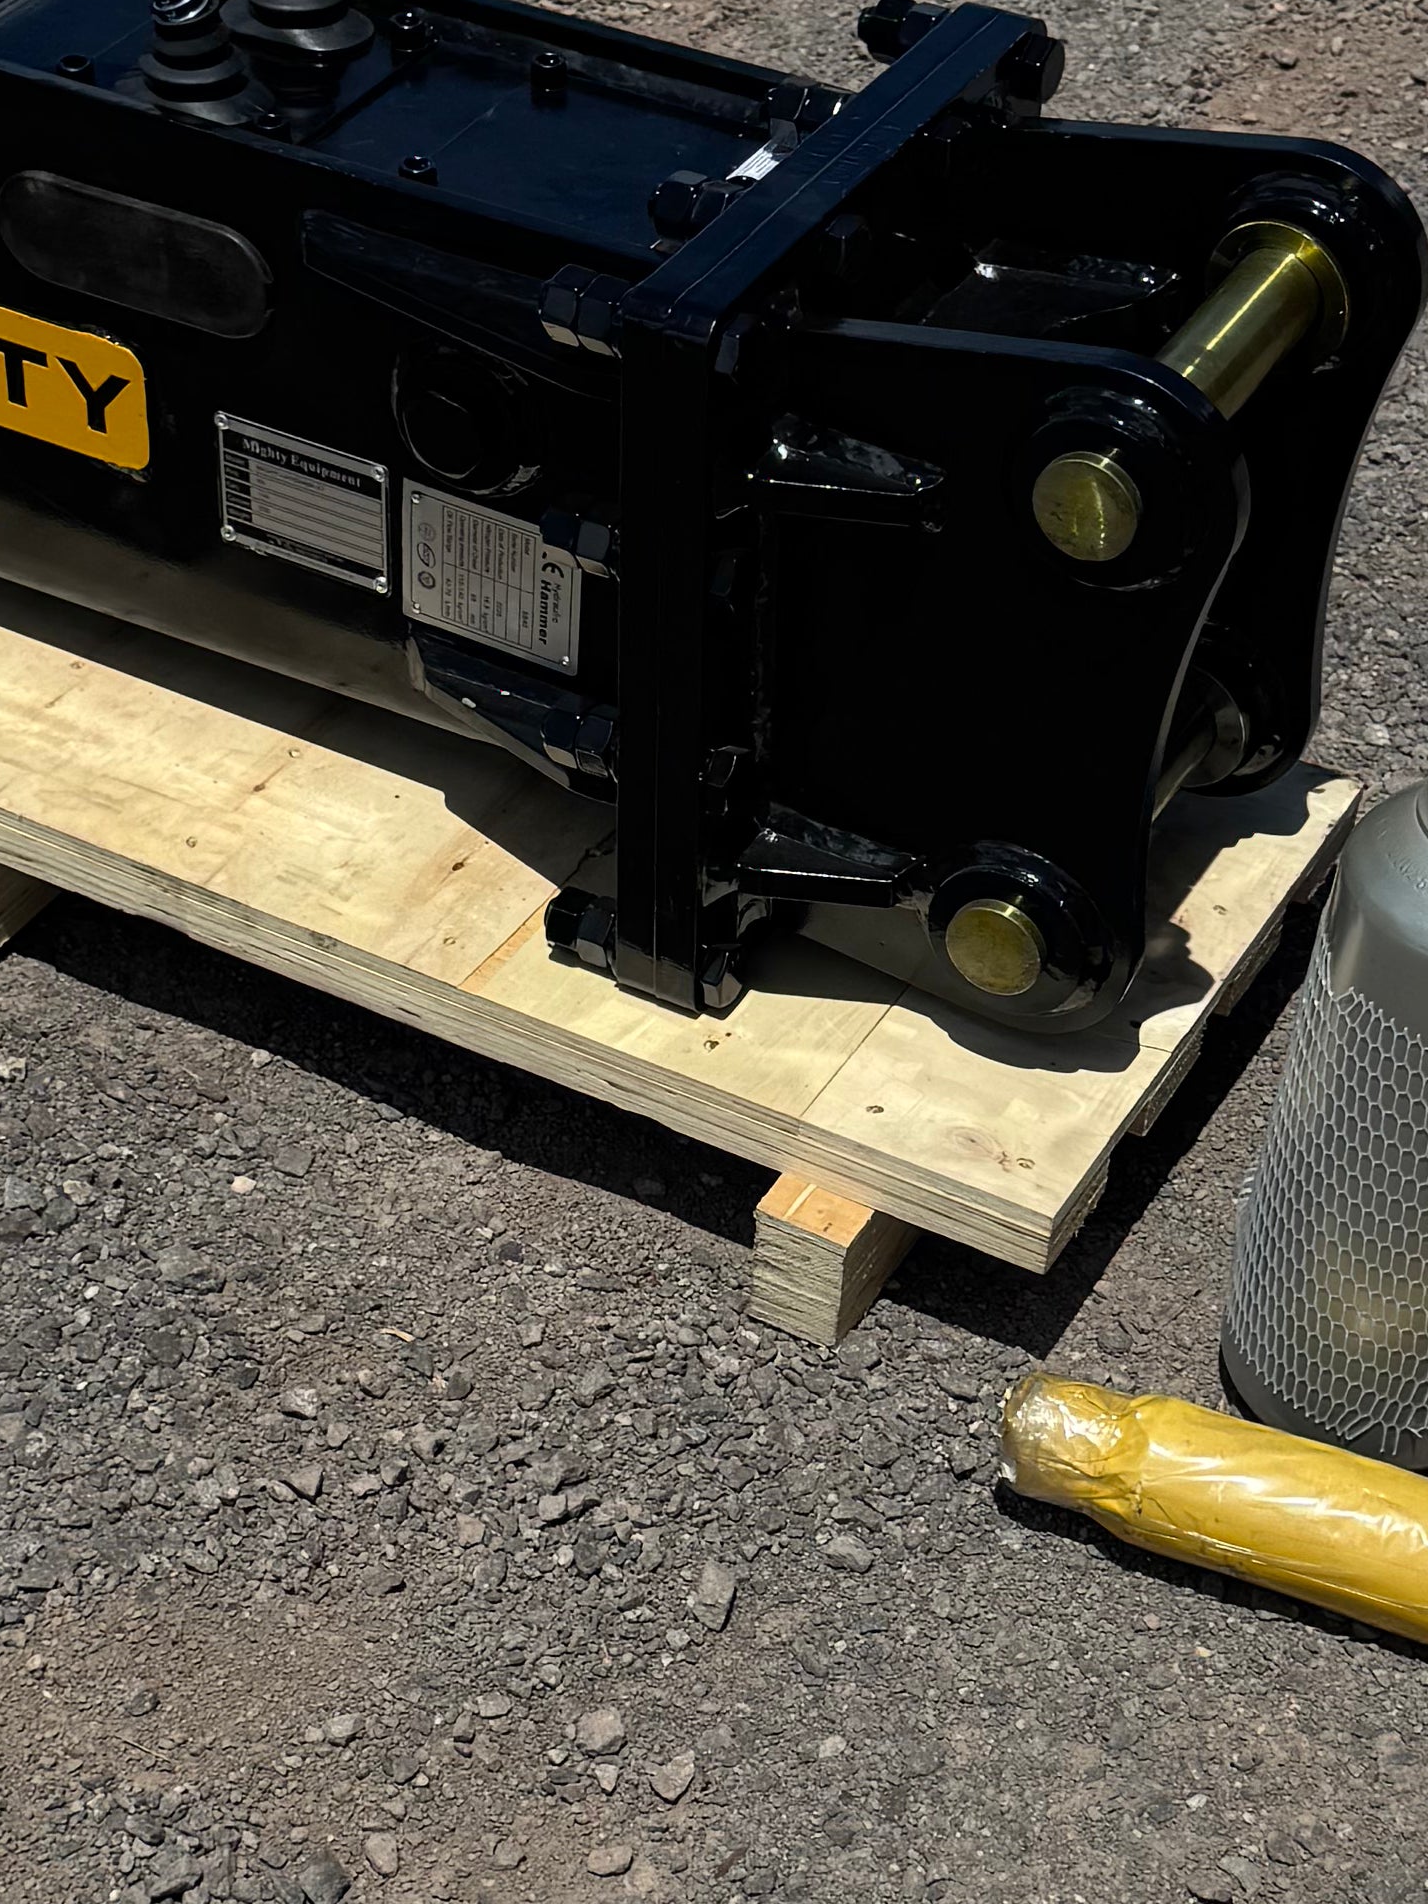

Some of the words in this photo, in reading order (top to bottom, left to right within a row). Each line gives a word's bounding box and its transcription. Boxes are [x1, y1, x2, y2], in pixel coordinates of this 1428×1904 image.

[242, 437, 287, 464] Mighty
[290, 453, 361, 489] Equipment
[539, 580, 551, 645] Hammer
